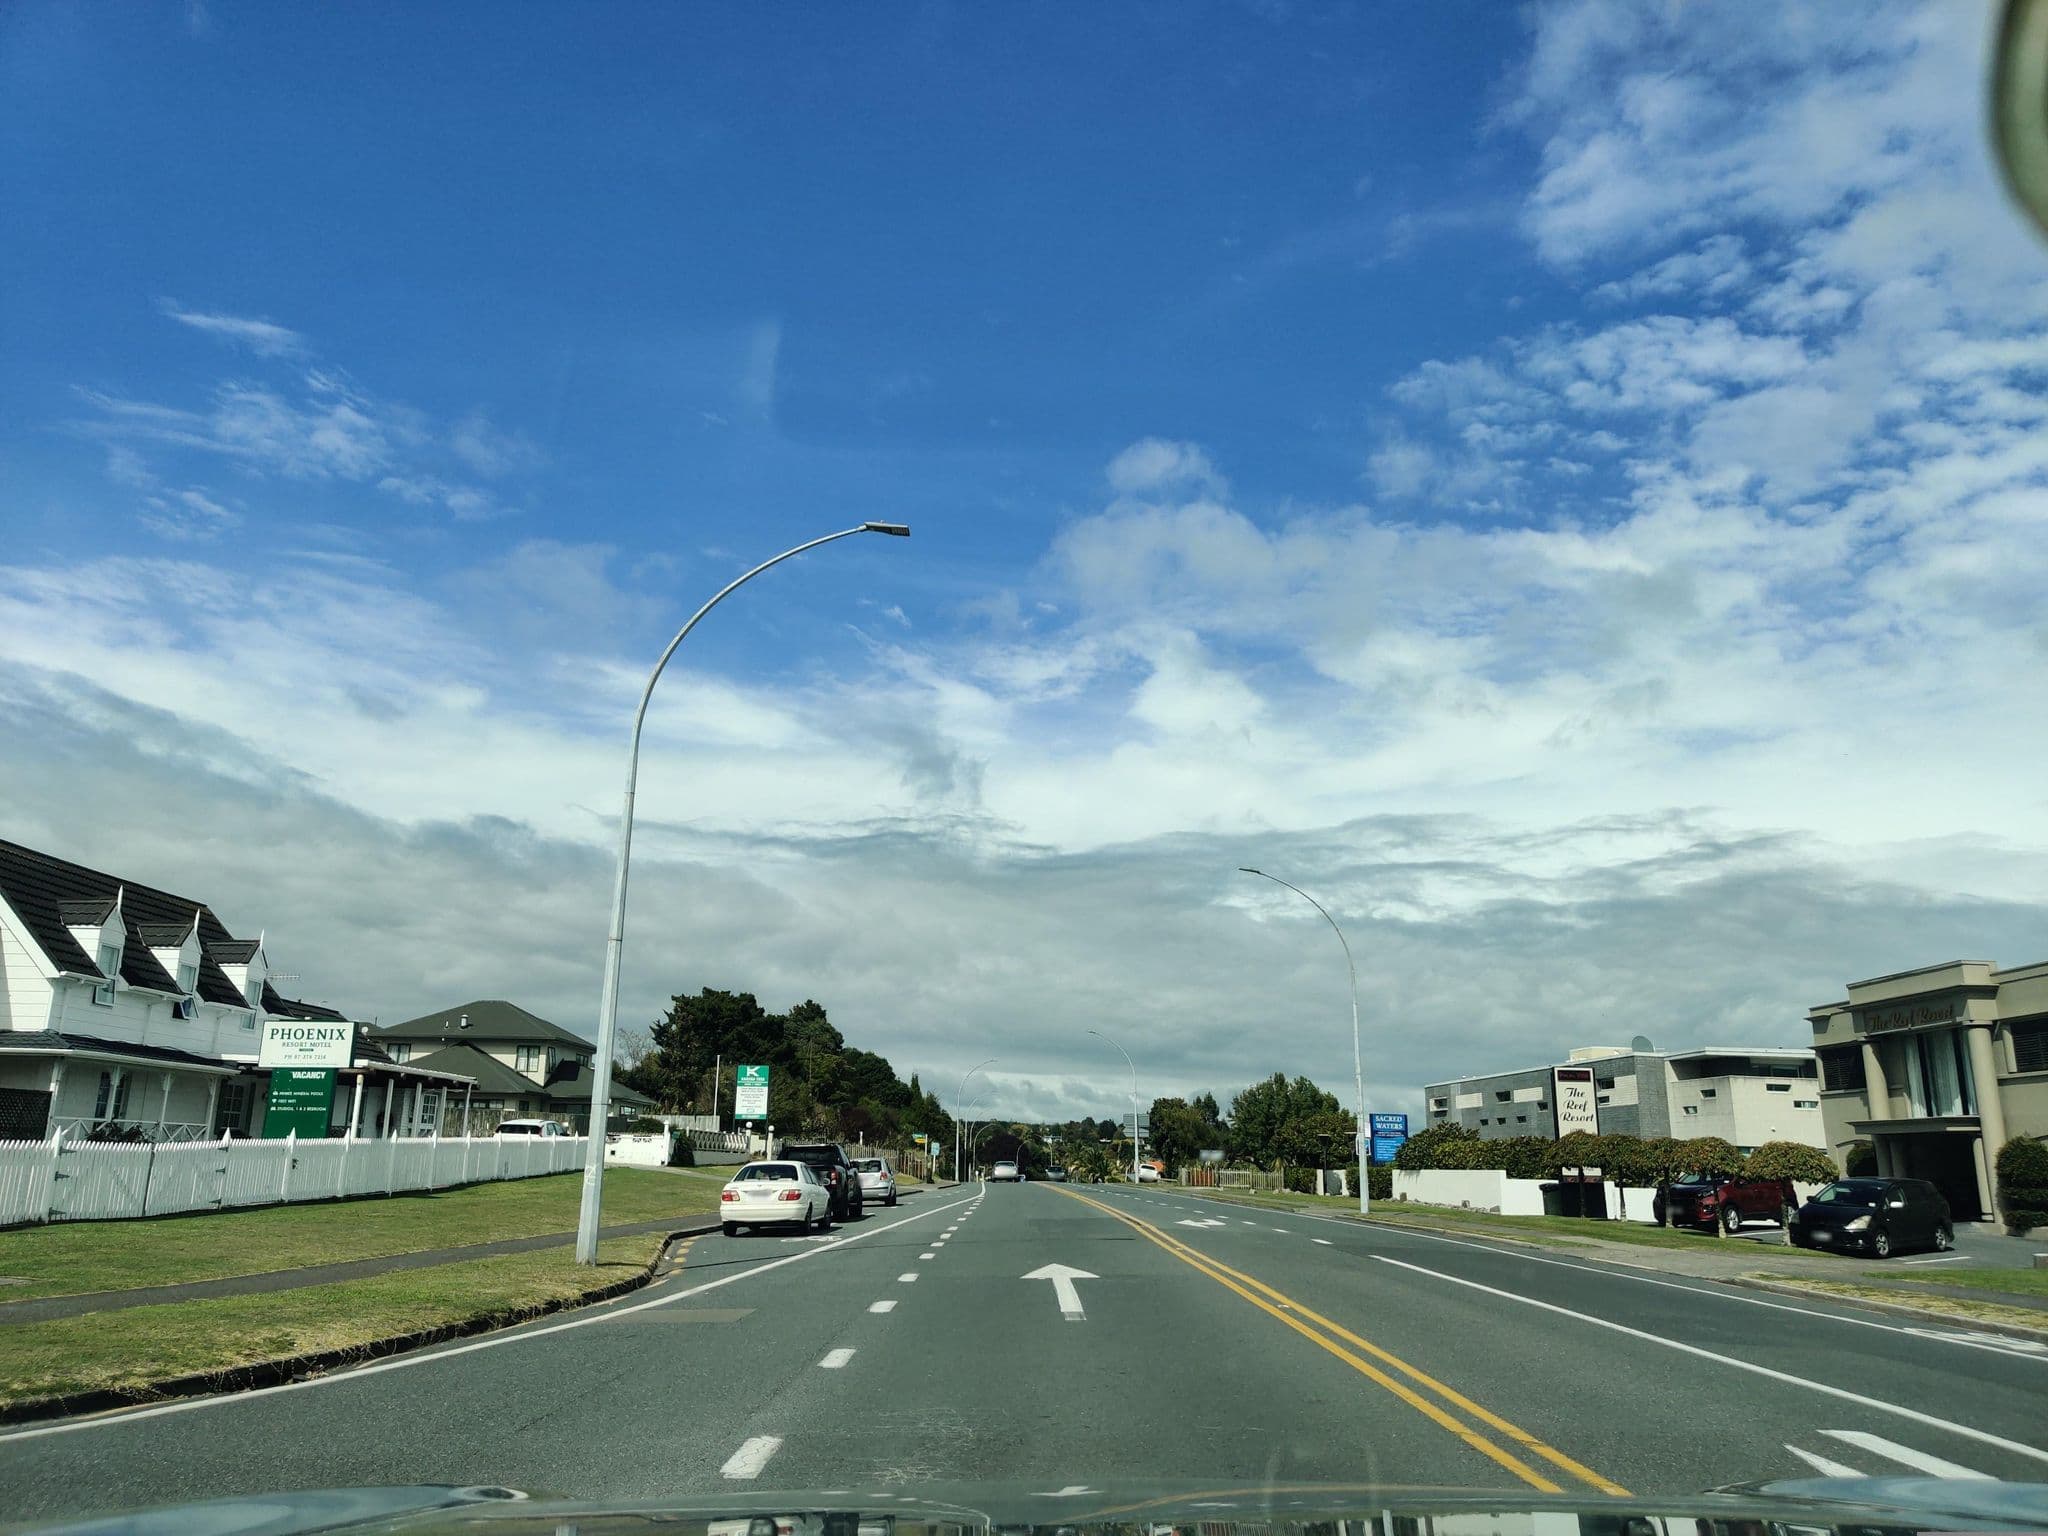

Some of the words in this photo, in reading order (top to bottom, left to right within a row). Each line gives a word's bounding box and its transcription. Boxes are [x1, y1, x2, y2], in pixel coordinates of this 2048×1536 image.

[270, 1028, 346, 1041] PHOENIX
[292, 1071, 326, 1079] VACANCY
[1564, 1087, 1585, 1097] The
[1563, 1099, 1587, 1112] Reef
[1560, 1112, 1594, 1122] Resort
